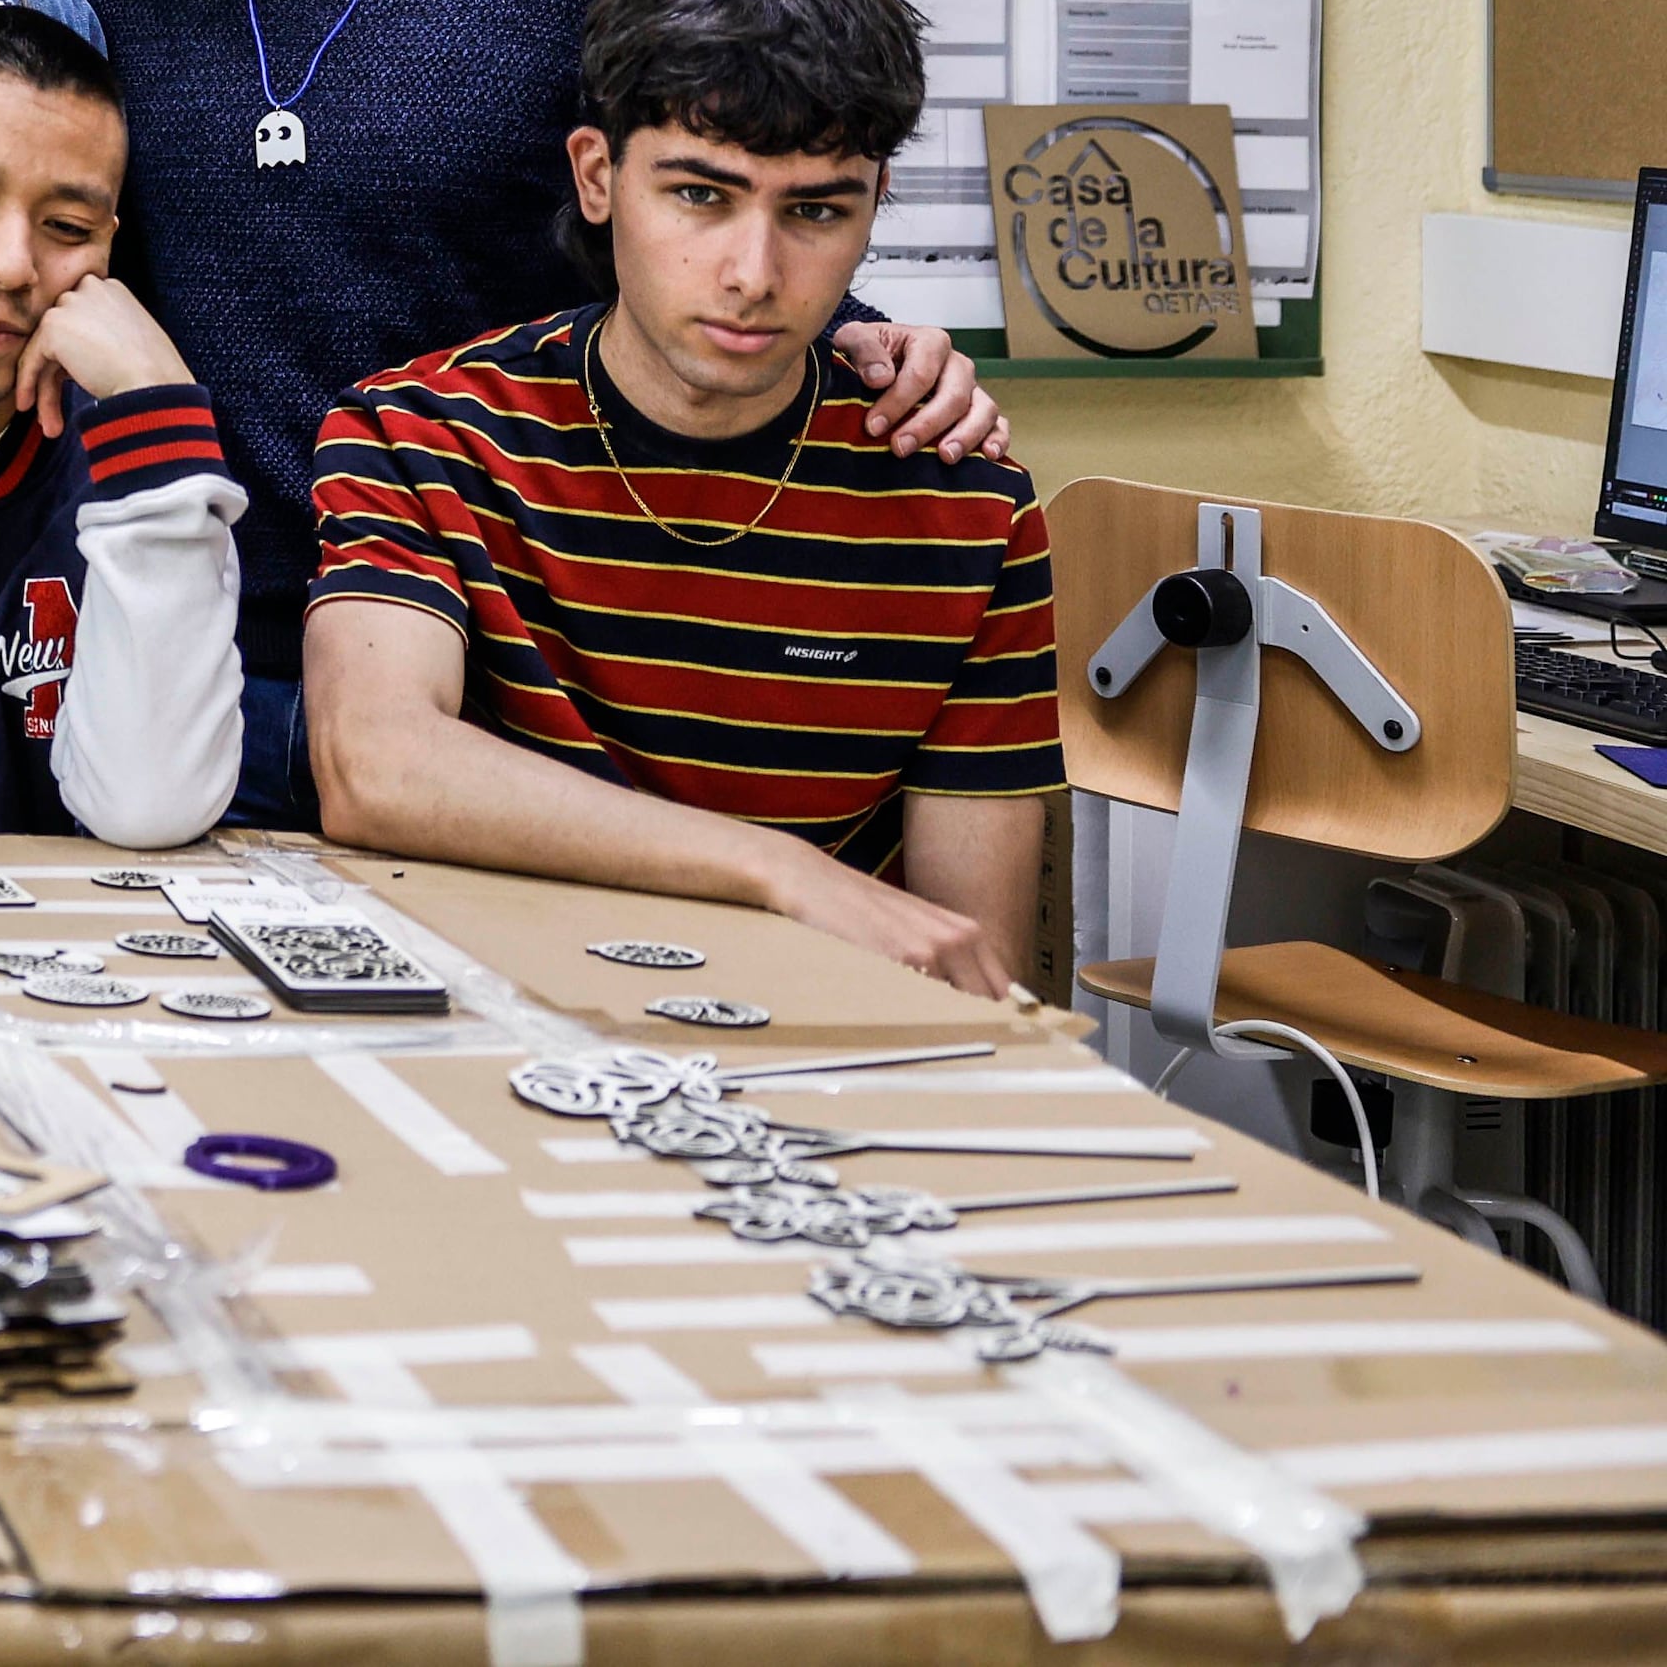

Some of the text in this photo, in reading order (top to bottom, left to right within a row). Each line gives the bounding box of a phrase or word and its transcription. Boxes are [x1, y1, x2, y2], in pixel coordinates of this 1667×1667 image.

[1004, 163, 1134, 207] Casa
[1049, 216, 1108, 250] de
[1057, 246, 1238, 291] Cultura
[784, 645, 845, 661] INSIGHT
